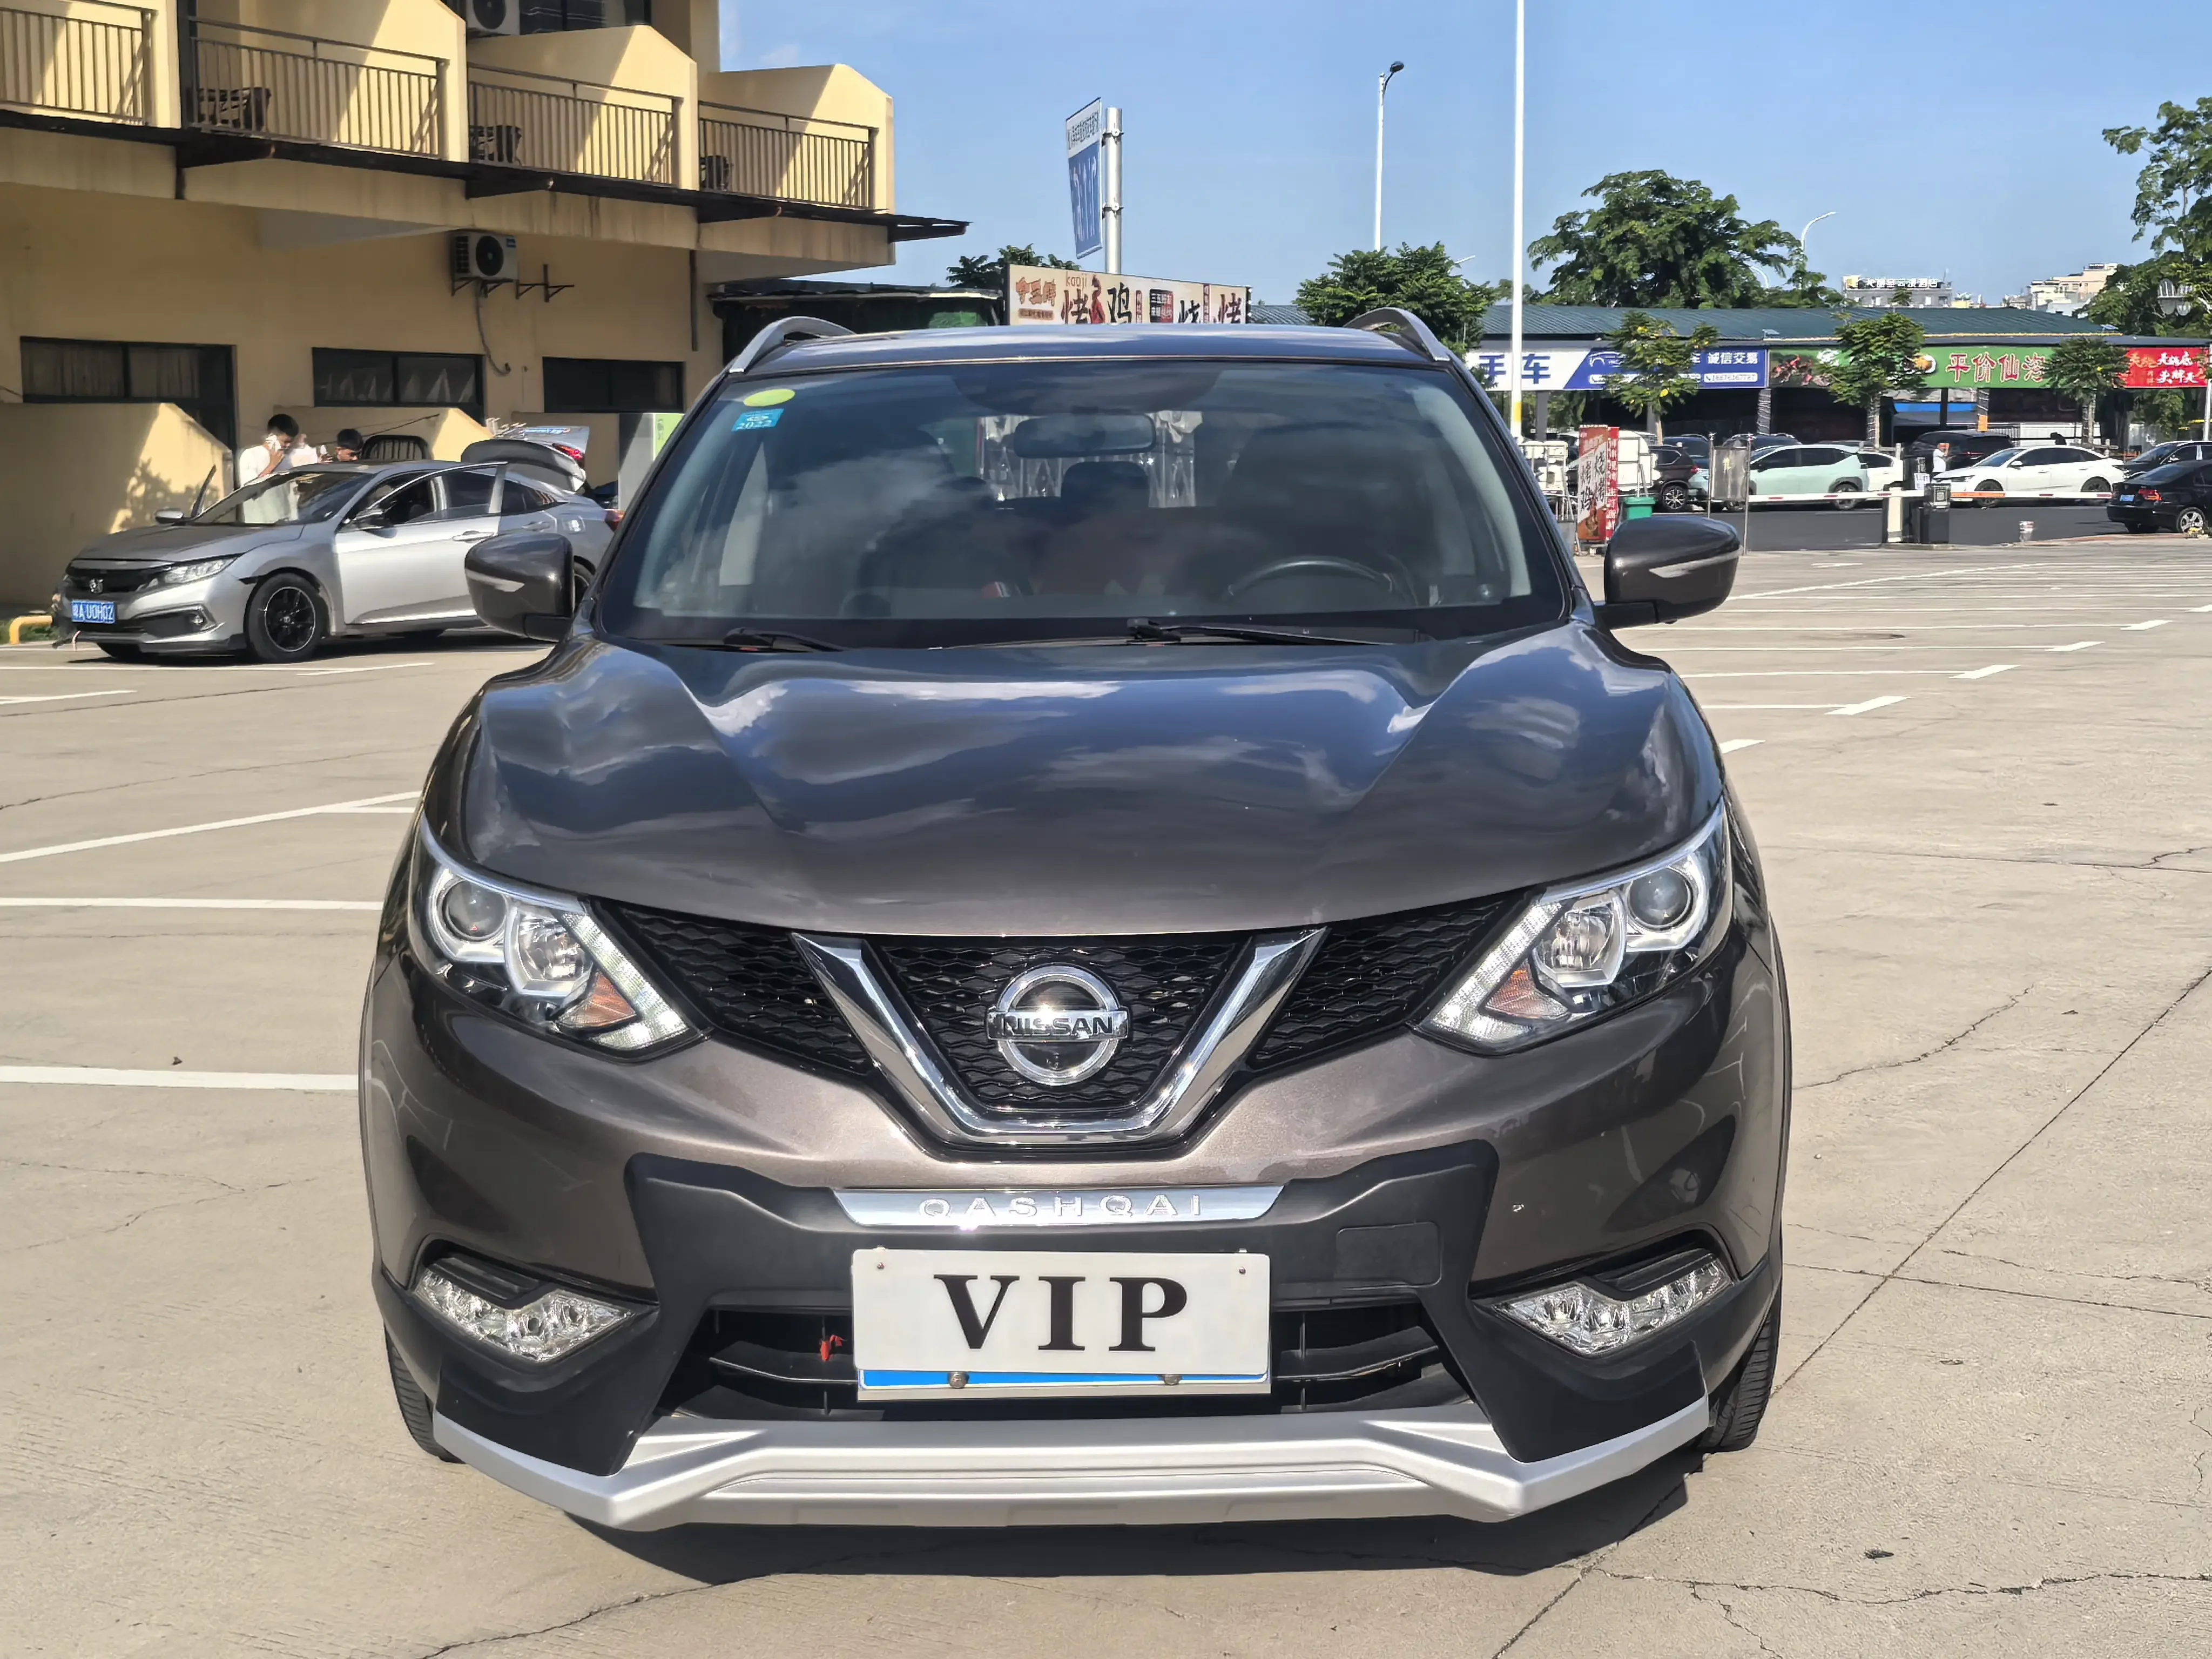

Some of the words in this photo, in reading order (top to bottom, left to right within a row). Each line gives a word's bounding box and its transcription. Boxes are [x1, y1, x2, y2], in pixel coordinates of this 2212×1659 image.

[1708, 352, 1758, 365] 诚信交易
[1001, 1016, 1114, 1036] NISSAN
[918, 1193, 1201, 1217] QASHQAI
[933, 1273, 1188, 1352] VIP
